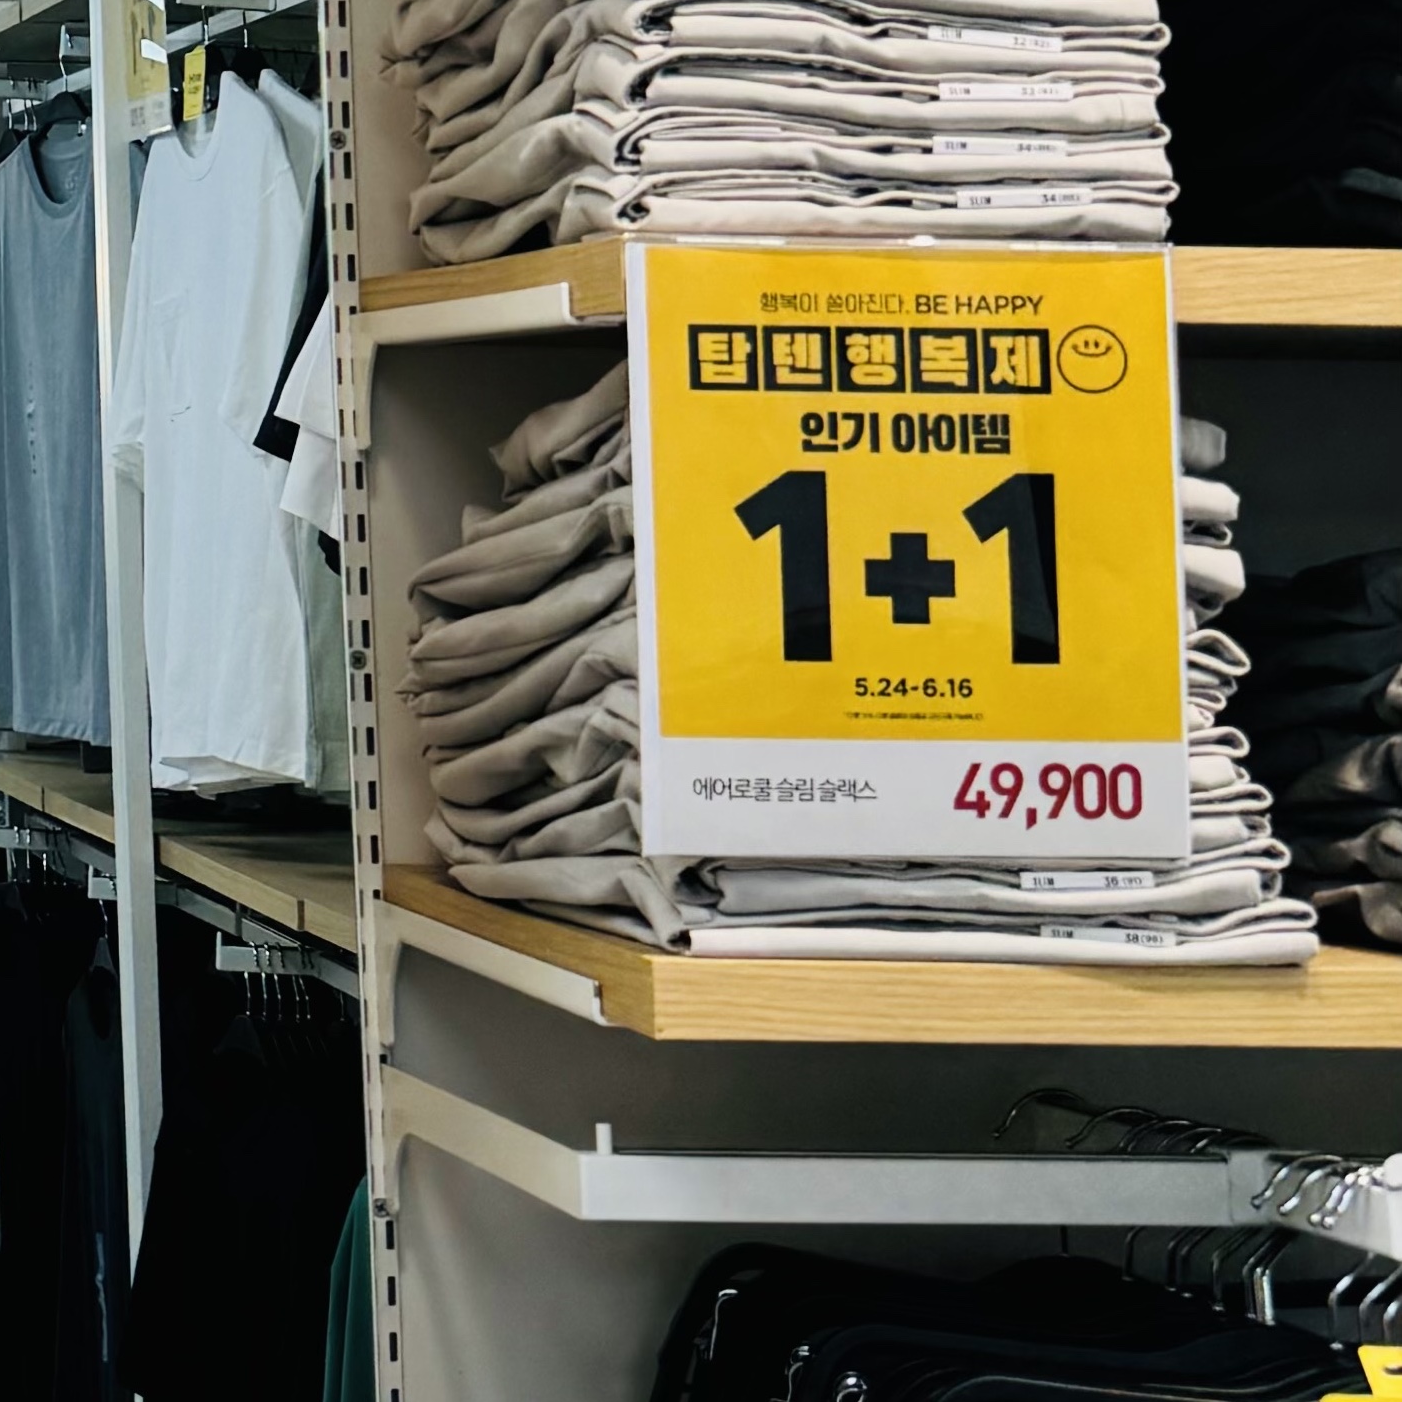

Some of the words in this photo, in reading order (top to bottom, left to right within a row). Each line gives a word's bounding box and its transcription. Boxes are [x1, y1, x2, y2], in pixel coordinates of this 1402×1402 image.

[949, 86, 971, 95] SLIM
[945, 141, 967, 150] SLIM
[969, 196, 992, 205] SLIM
[759, 292, 819, 314] 행복이
[915, 294, 949, 314] BE
[955, 294, 1044, 316] HAPPY
[693, 329, 1045, 390] 탑텐행복제
[799, 411, 881, 453] 인기
[891, 412, 1011, 454] 아이템
[734, 470, 1060, 664] 1+1
[854, 677, 974, 698] 5.24-6.16
[953, 762, 1142, 831] 49,900
[1032, 877, 1055, 887] SLIM
[1051, 929, 1074, 938] SLIM
